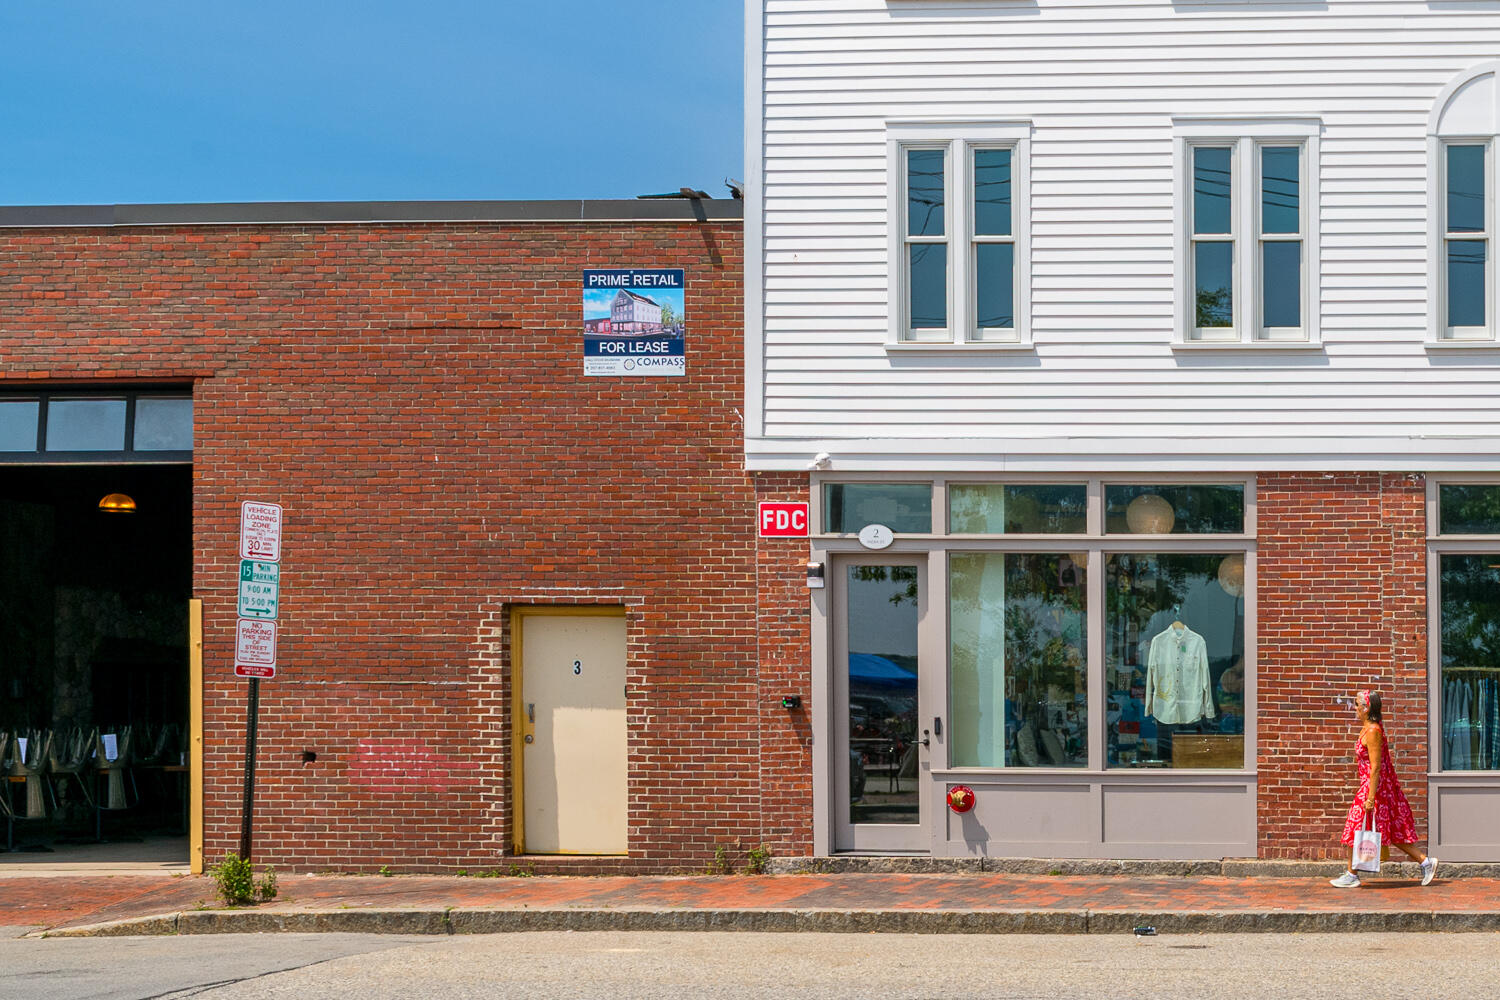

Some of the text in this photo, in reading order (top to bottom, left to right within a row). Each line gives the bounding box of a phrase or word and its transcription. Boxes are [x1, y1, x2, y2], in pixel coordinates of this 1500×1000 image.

[589, 274, 678, 286] PRIME RETAIL
[599, 342, 669, 353] FOR LEASE
[636, 357, 685, 367] COMPASS
[247, 506, 277, 515] VEHICLE
[246, 513, 278, 523] LOADING
[762, 510, 805, 530] FDC
[251, 521, 271, 529] ZONE
[873, 529, 879, 538] 2
[247, 540, 260, 551] 30
[243, 564, 271, 577] 15 MIN
[253, 572, 277, 582] PARKING
[263, 586, 271, 594] AM
[242, 596, 249, 605] TO
[267, 599, 275, 607] PM
[241, 628, 272, 636] PARKING
[574, 660, 581, 675] 3
